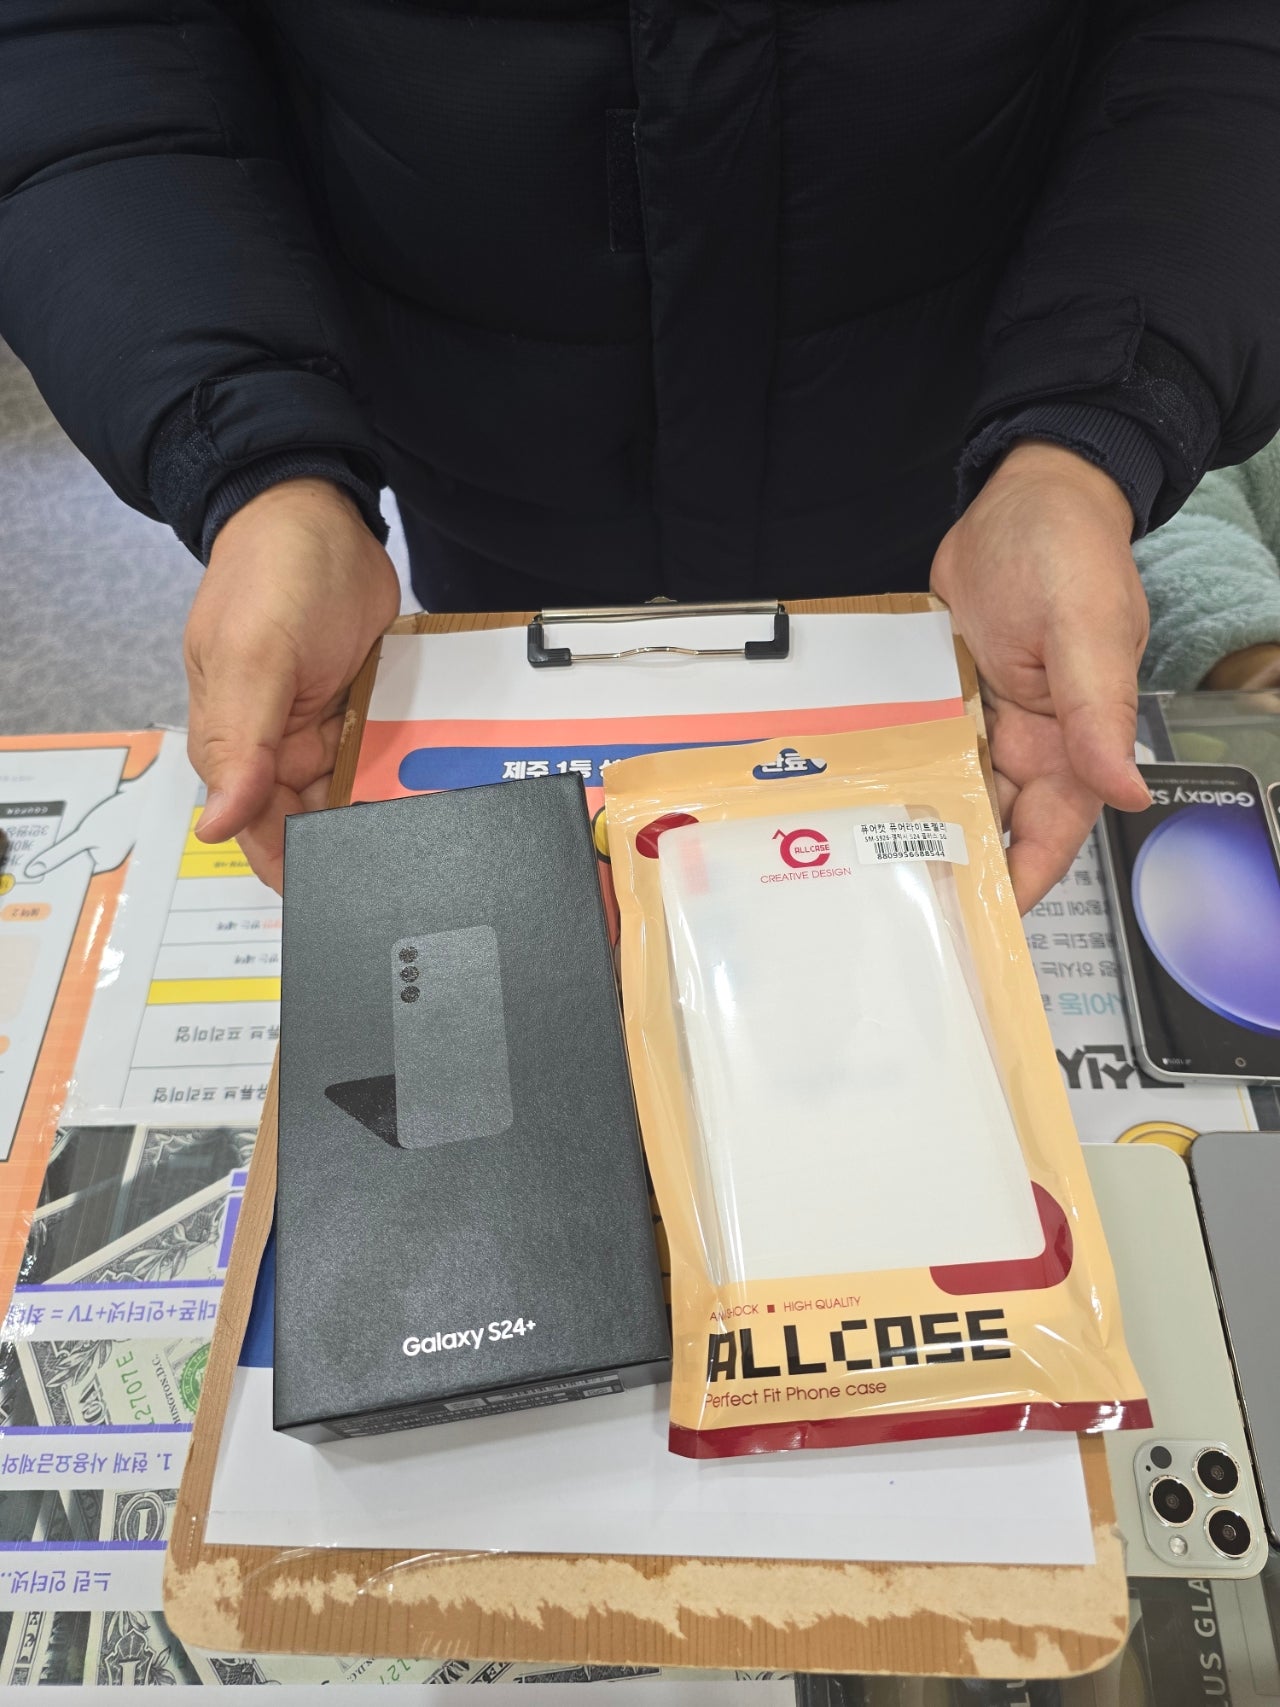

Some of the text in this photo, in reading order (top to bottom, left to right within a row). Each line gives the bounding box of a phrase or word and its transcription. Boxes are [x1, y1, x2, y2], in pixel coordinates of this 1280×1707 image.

[502, 760, 549, 779] 제주
[1173, 786, 1255, 807] Galaxy
[794, 844, 831, 854] ALLCASE
[760, 867, 852, 884] CREATIVE DESIGN
[1039, 961, 1095, 978] 하시는
[175, 1025, 244, 1043] 프리미엄
[153, 1086, 218, 1104] 프리미엄
[783, 1300, 812, 1312] HIGH
[815, 1296, 861, 1310] QUALITY
[402, 1317, 537, 1357] Galaxy S24+
[706, 1308, 1011, 1383] ALLCASE
[704, 1382, 887, 1409] Perfect Fit Phone case
[0, 1452, 108, 1475] 사용요금제와
[113, 1452, 149, 1474] 현재
[72, 1570, 112, 1594] 느린
[1200, 1652, 1230, 1707] US
